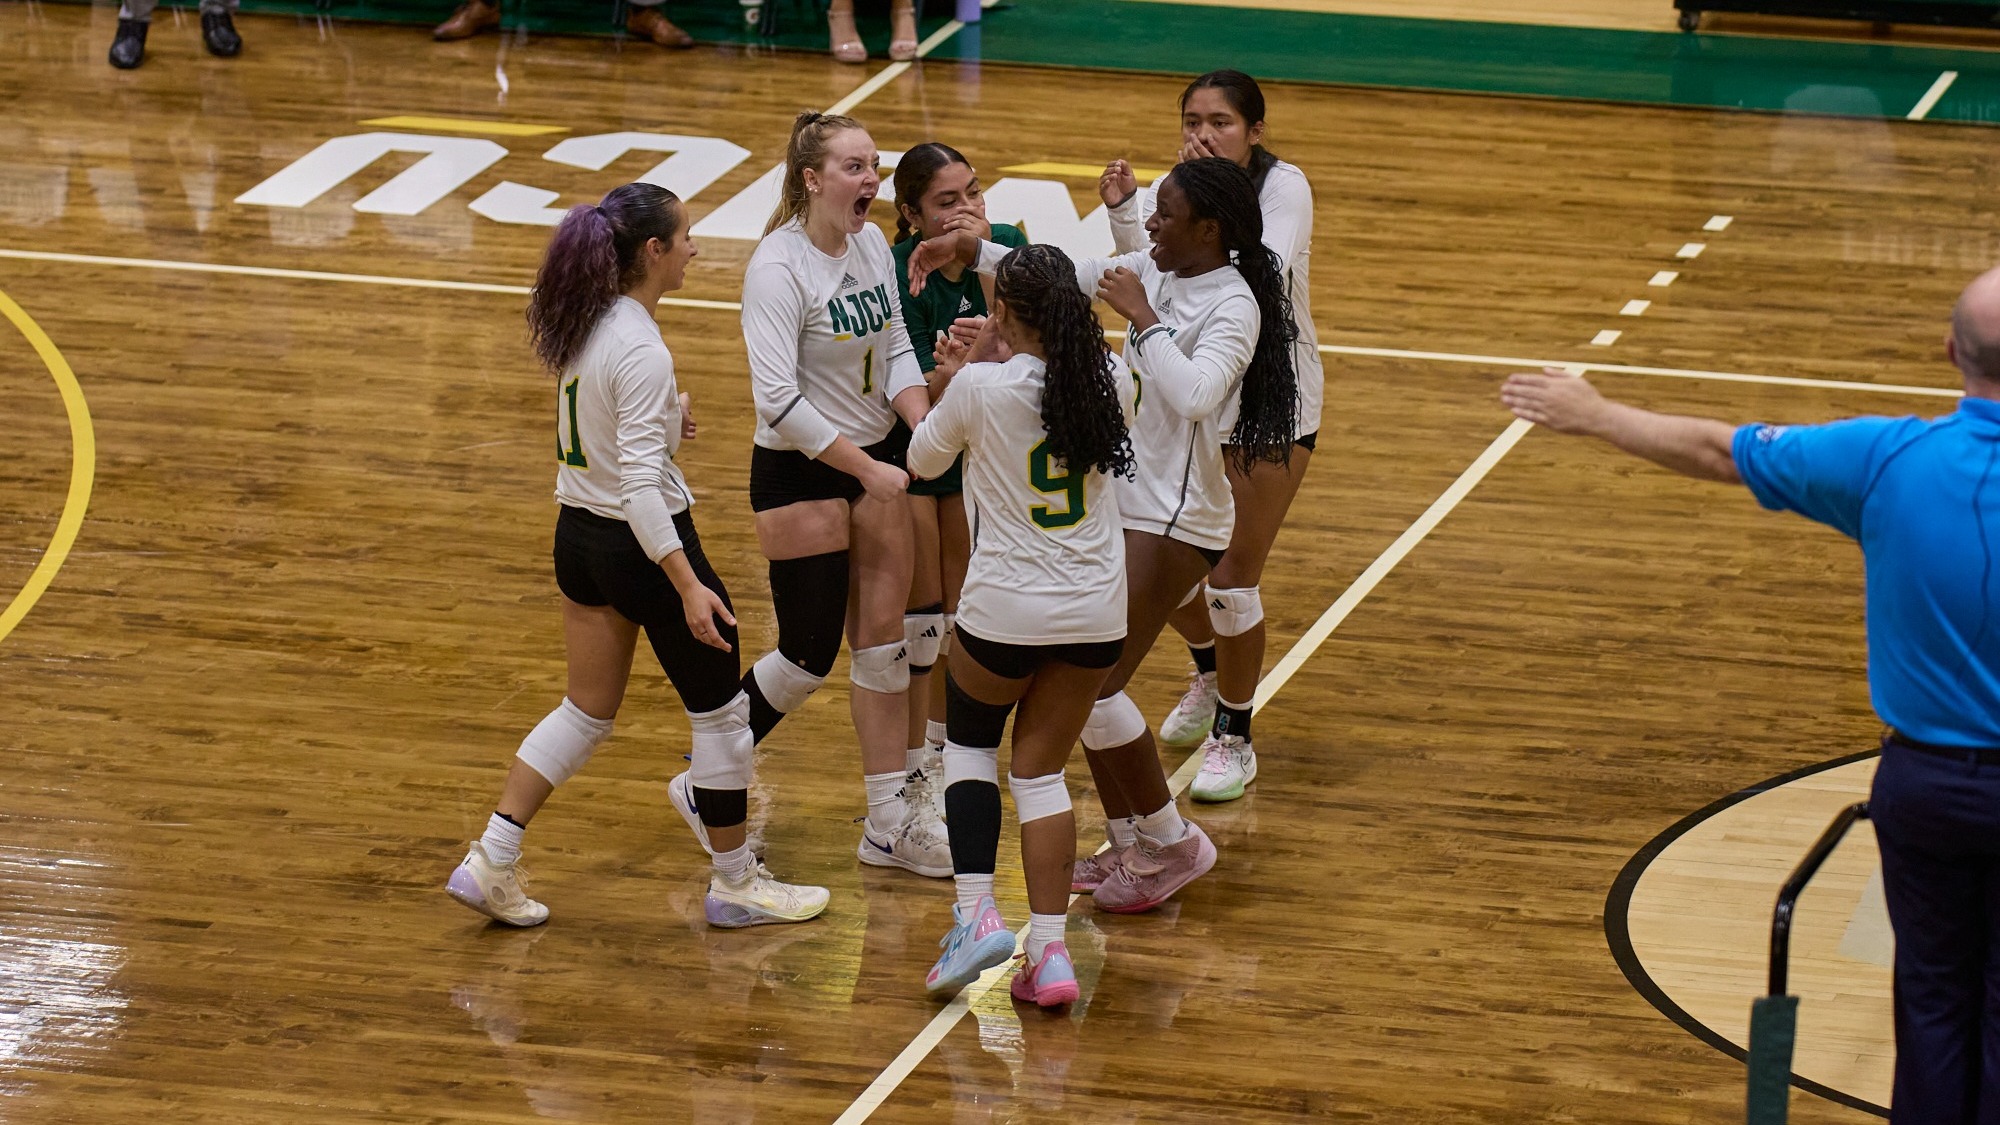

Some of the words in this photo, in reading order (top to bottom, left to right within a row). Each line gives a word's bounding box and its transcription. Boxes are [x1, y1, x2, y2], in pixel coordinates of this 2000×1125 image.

[827, 283, 892, 338] NJCU
[862, 346, 874, 395] 1
[1028, 438, 1088, 531] 9
